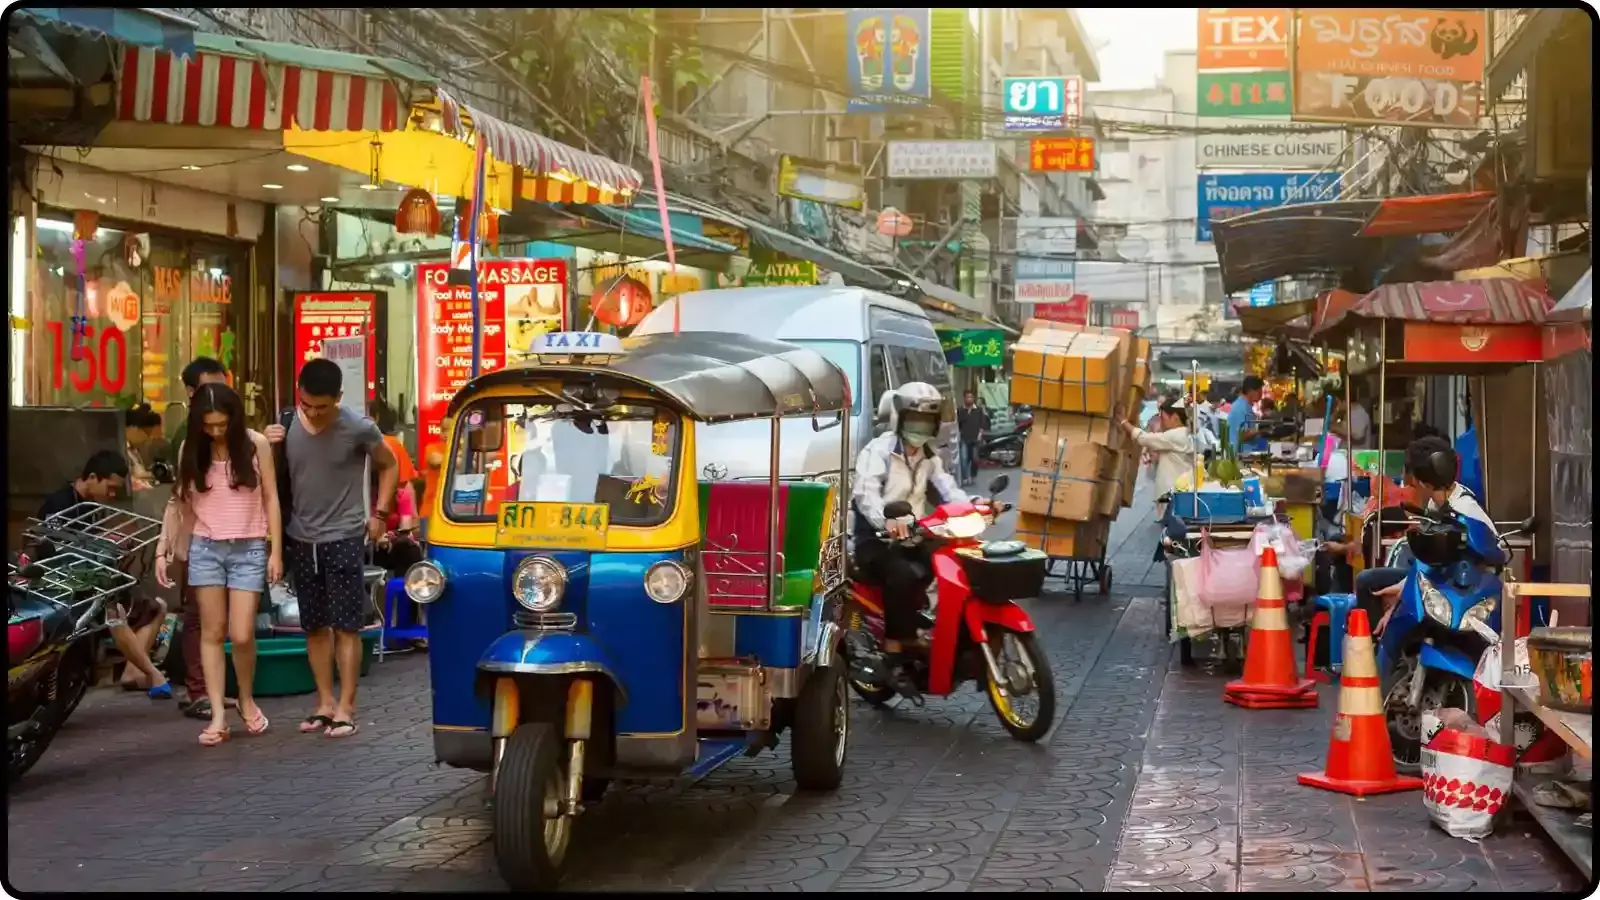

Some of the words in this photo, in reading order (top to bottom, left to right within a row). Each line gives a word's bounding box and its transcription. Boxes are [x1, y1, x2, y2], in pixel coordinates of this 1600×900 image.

[1419, 64, 1455, 75] FOOD
[1010, 80, 1058, 112] ยา
[1330, 74, 1458, 117] FOOD
[1203, 143, 1270, 157] CHINESE
[1274, 142, 1337, 156] CUISINE
[1205, 175, 1274, 201] ที่จอดรถ
[765, 263, 800, 276] ATM
[432, 289, 453, 300] Foot
[431, 321, 454, 336] Body
[545, 333, 602, 347] TAXI
[46, 321, 126, 394] 150
[435, 355, 451, 367] Oil
